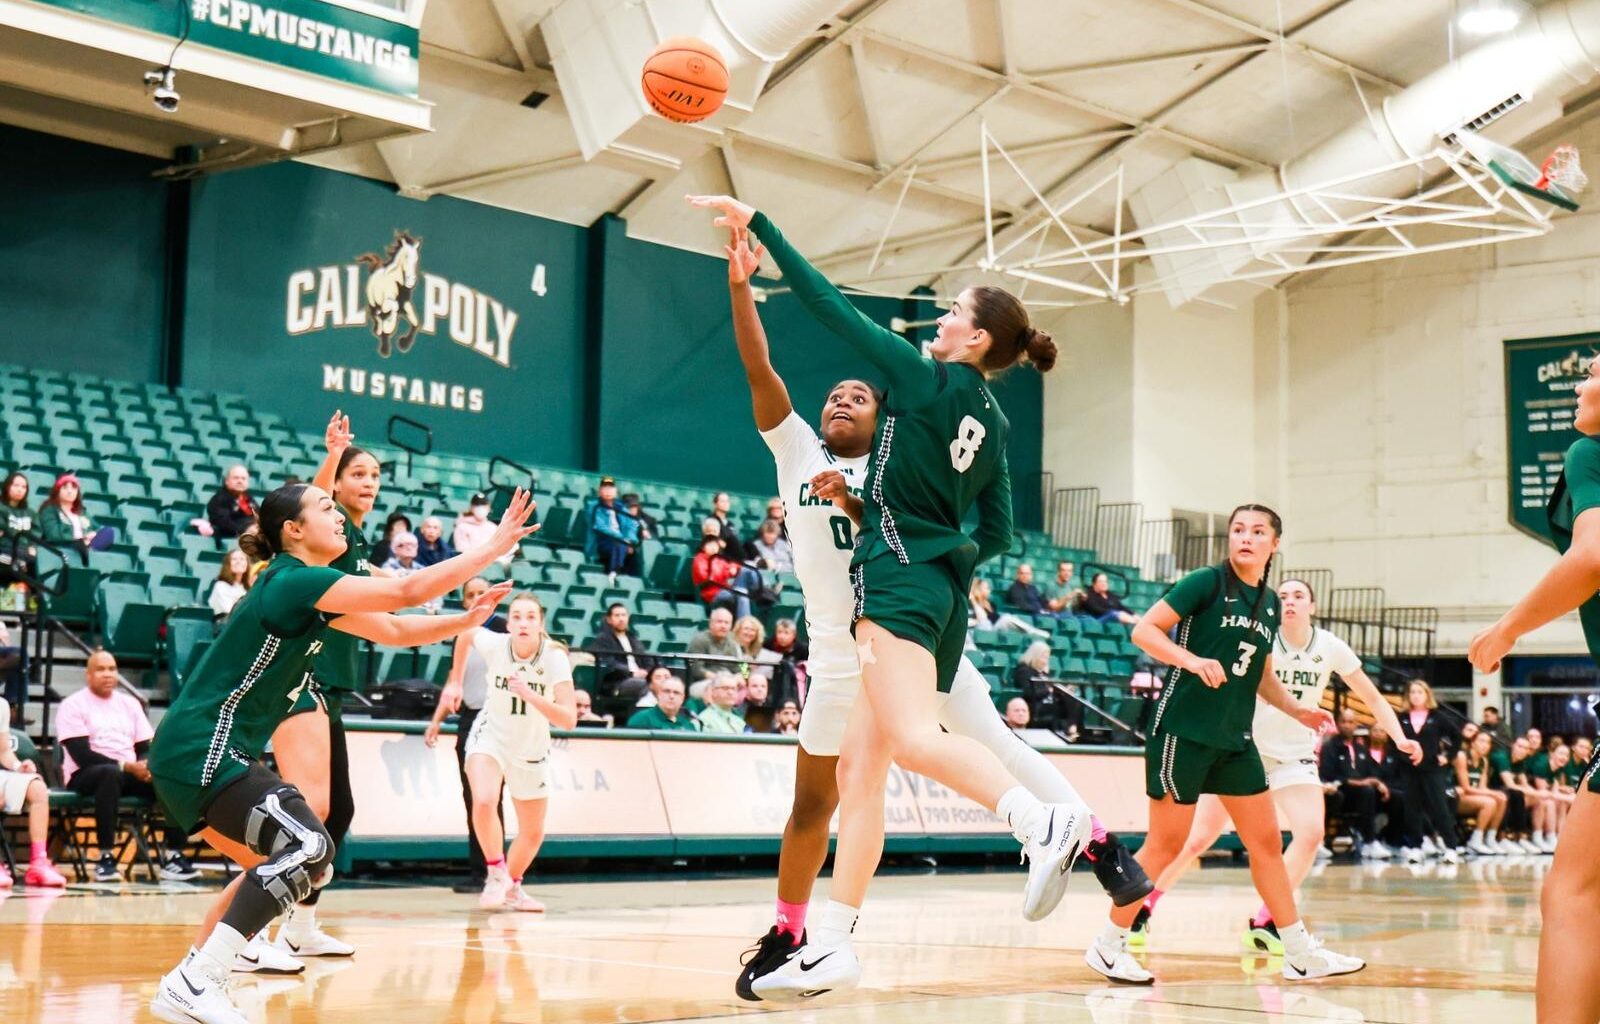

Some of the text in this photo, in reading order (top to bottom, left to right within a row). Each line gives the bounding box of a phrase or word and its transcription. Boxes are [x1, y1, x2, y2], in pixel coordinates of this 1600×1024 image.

[191, 0, 411, 73] #CPMUSTANGS
[530, 264, 547, 297] 4
[286, 264, 518, 368] CAL POLY
[323, 364, 484, 412] MUSTANGS
[949, 414, 986, 474] 8
[829, 515, 854, 550] 0
[1231, 641, 1257, 677] 3
[1292, 670, 1321, 687] POLY
[511, 696, 527, 716] 11
